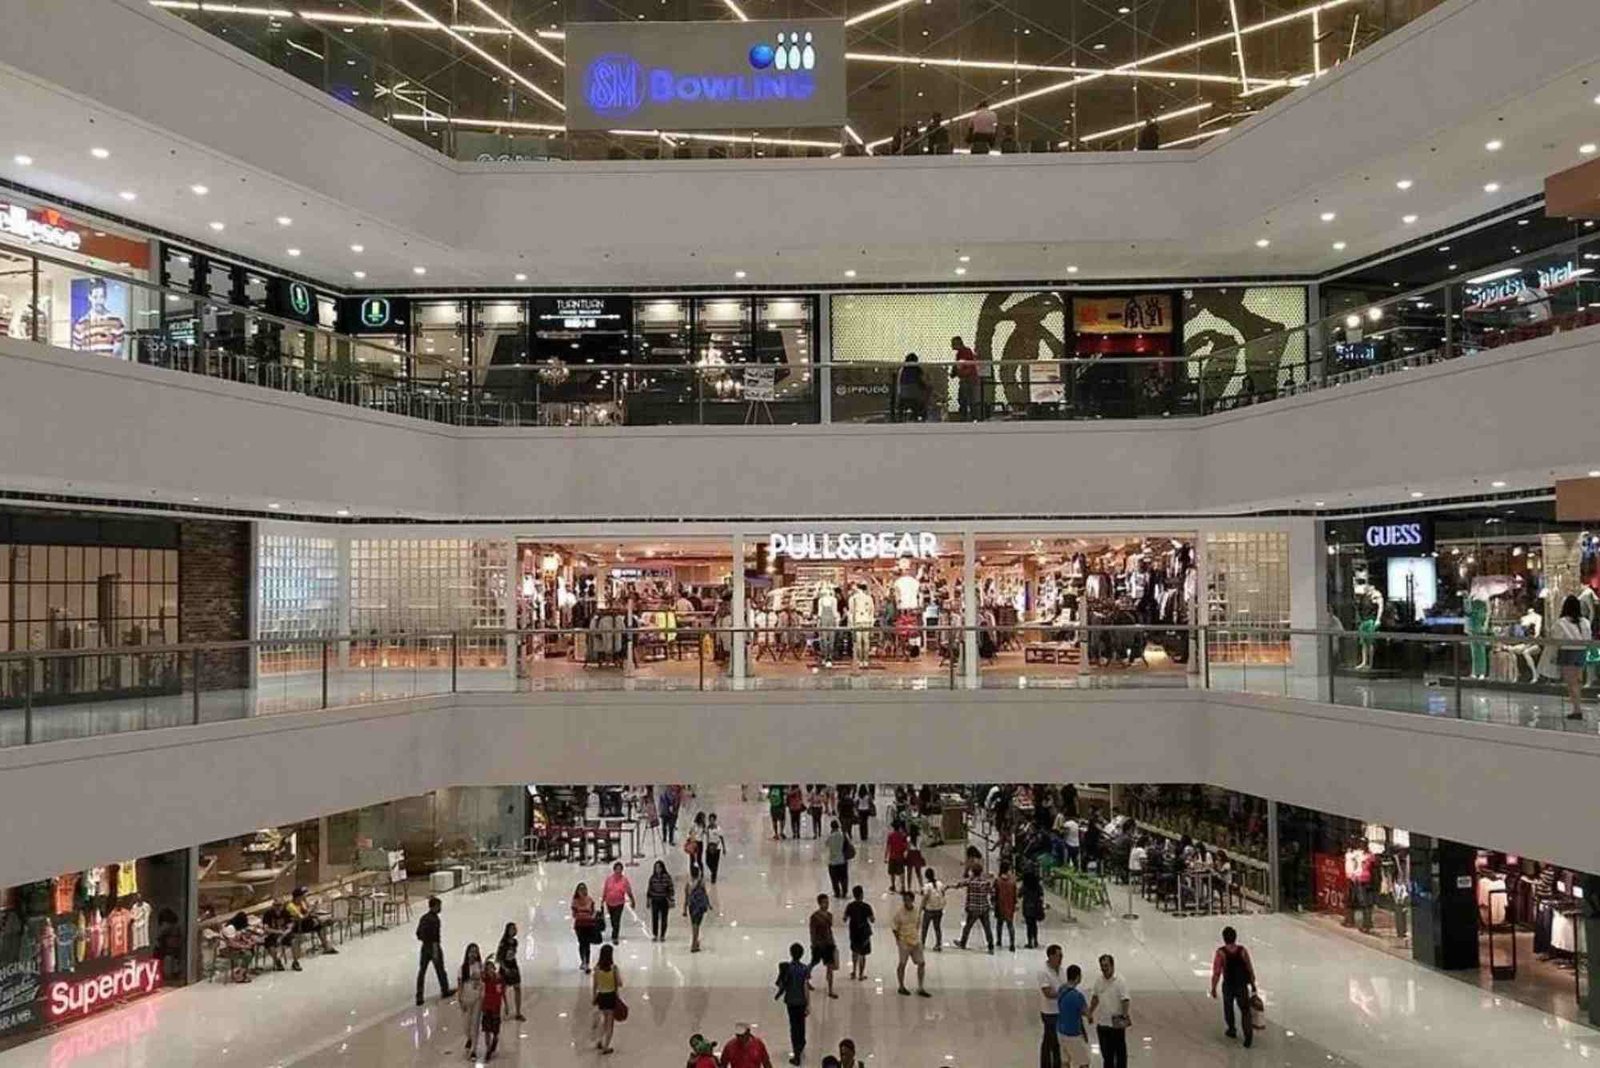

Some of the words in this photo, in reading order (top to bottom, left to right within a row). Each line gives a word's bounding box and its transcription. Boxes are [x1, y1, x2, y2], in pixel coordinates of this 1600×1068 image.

[591, 60, 639, 110] SM
[768, 532, 938, 560] PULL&BEAR
[1366, 523, 1422, 547] GUESS
